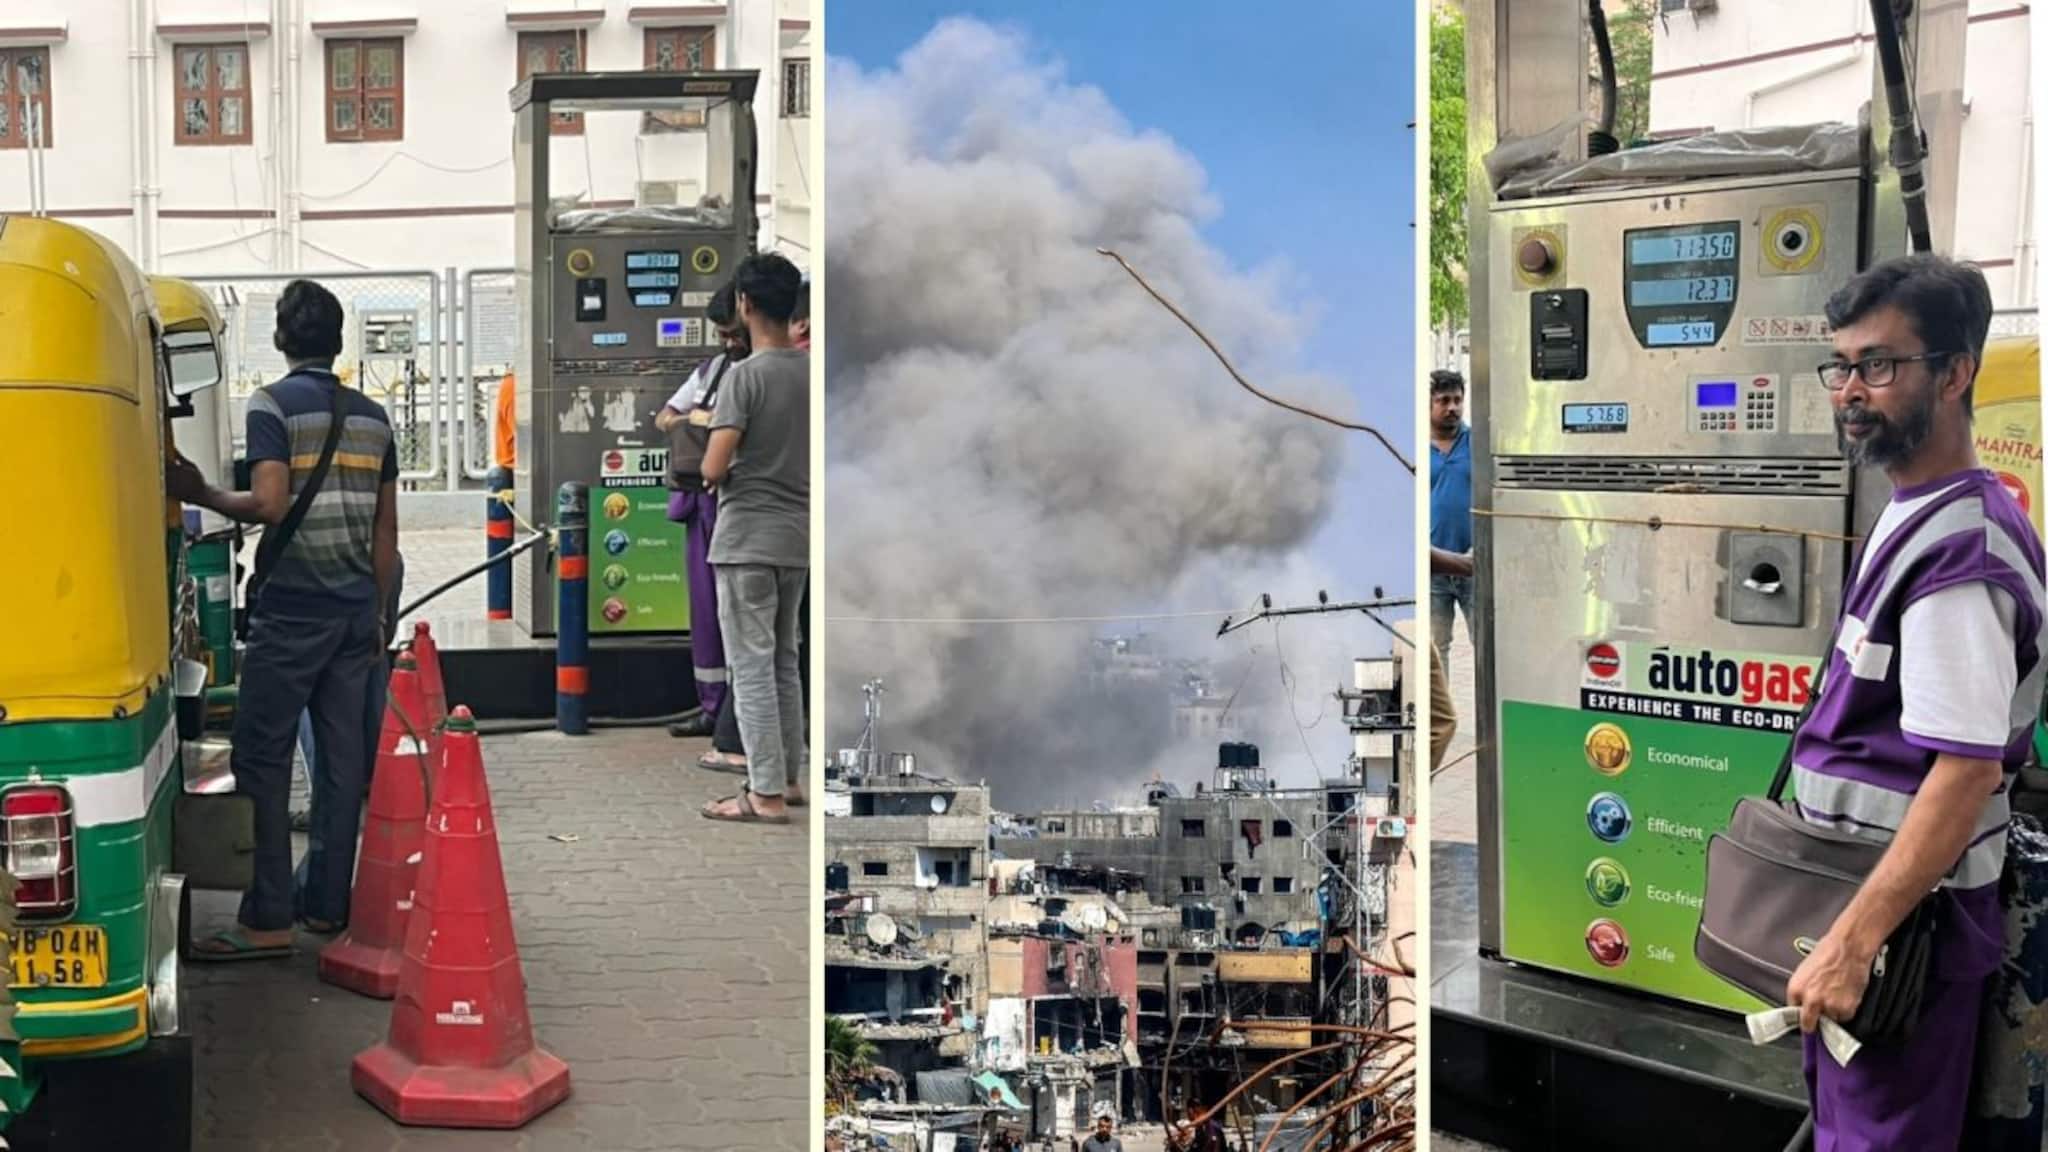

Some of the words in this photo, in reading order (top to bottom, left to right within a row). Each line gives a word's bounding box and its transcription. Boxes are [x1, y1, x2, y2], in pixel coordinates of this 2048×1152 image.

[1673, 234, 1733, 259] 713.50
[1687, 278, 1732, 301] 12.37
[1681, 324, 1713, 341] 544
[1588, 692, 1682, 718] EXPERIENCE
[1693, 704, 1722, 722] THE
[1732, 708, 1800, 731] ECO-DR
[1647, 746, 1729, 772] Economical
[1647, 816, 1703, 840] Efficient
[52, 929, 99, 956] 04H
[1646, 944, 1676, 963] Safe
